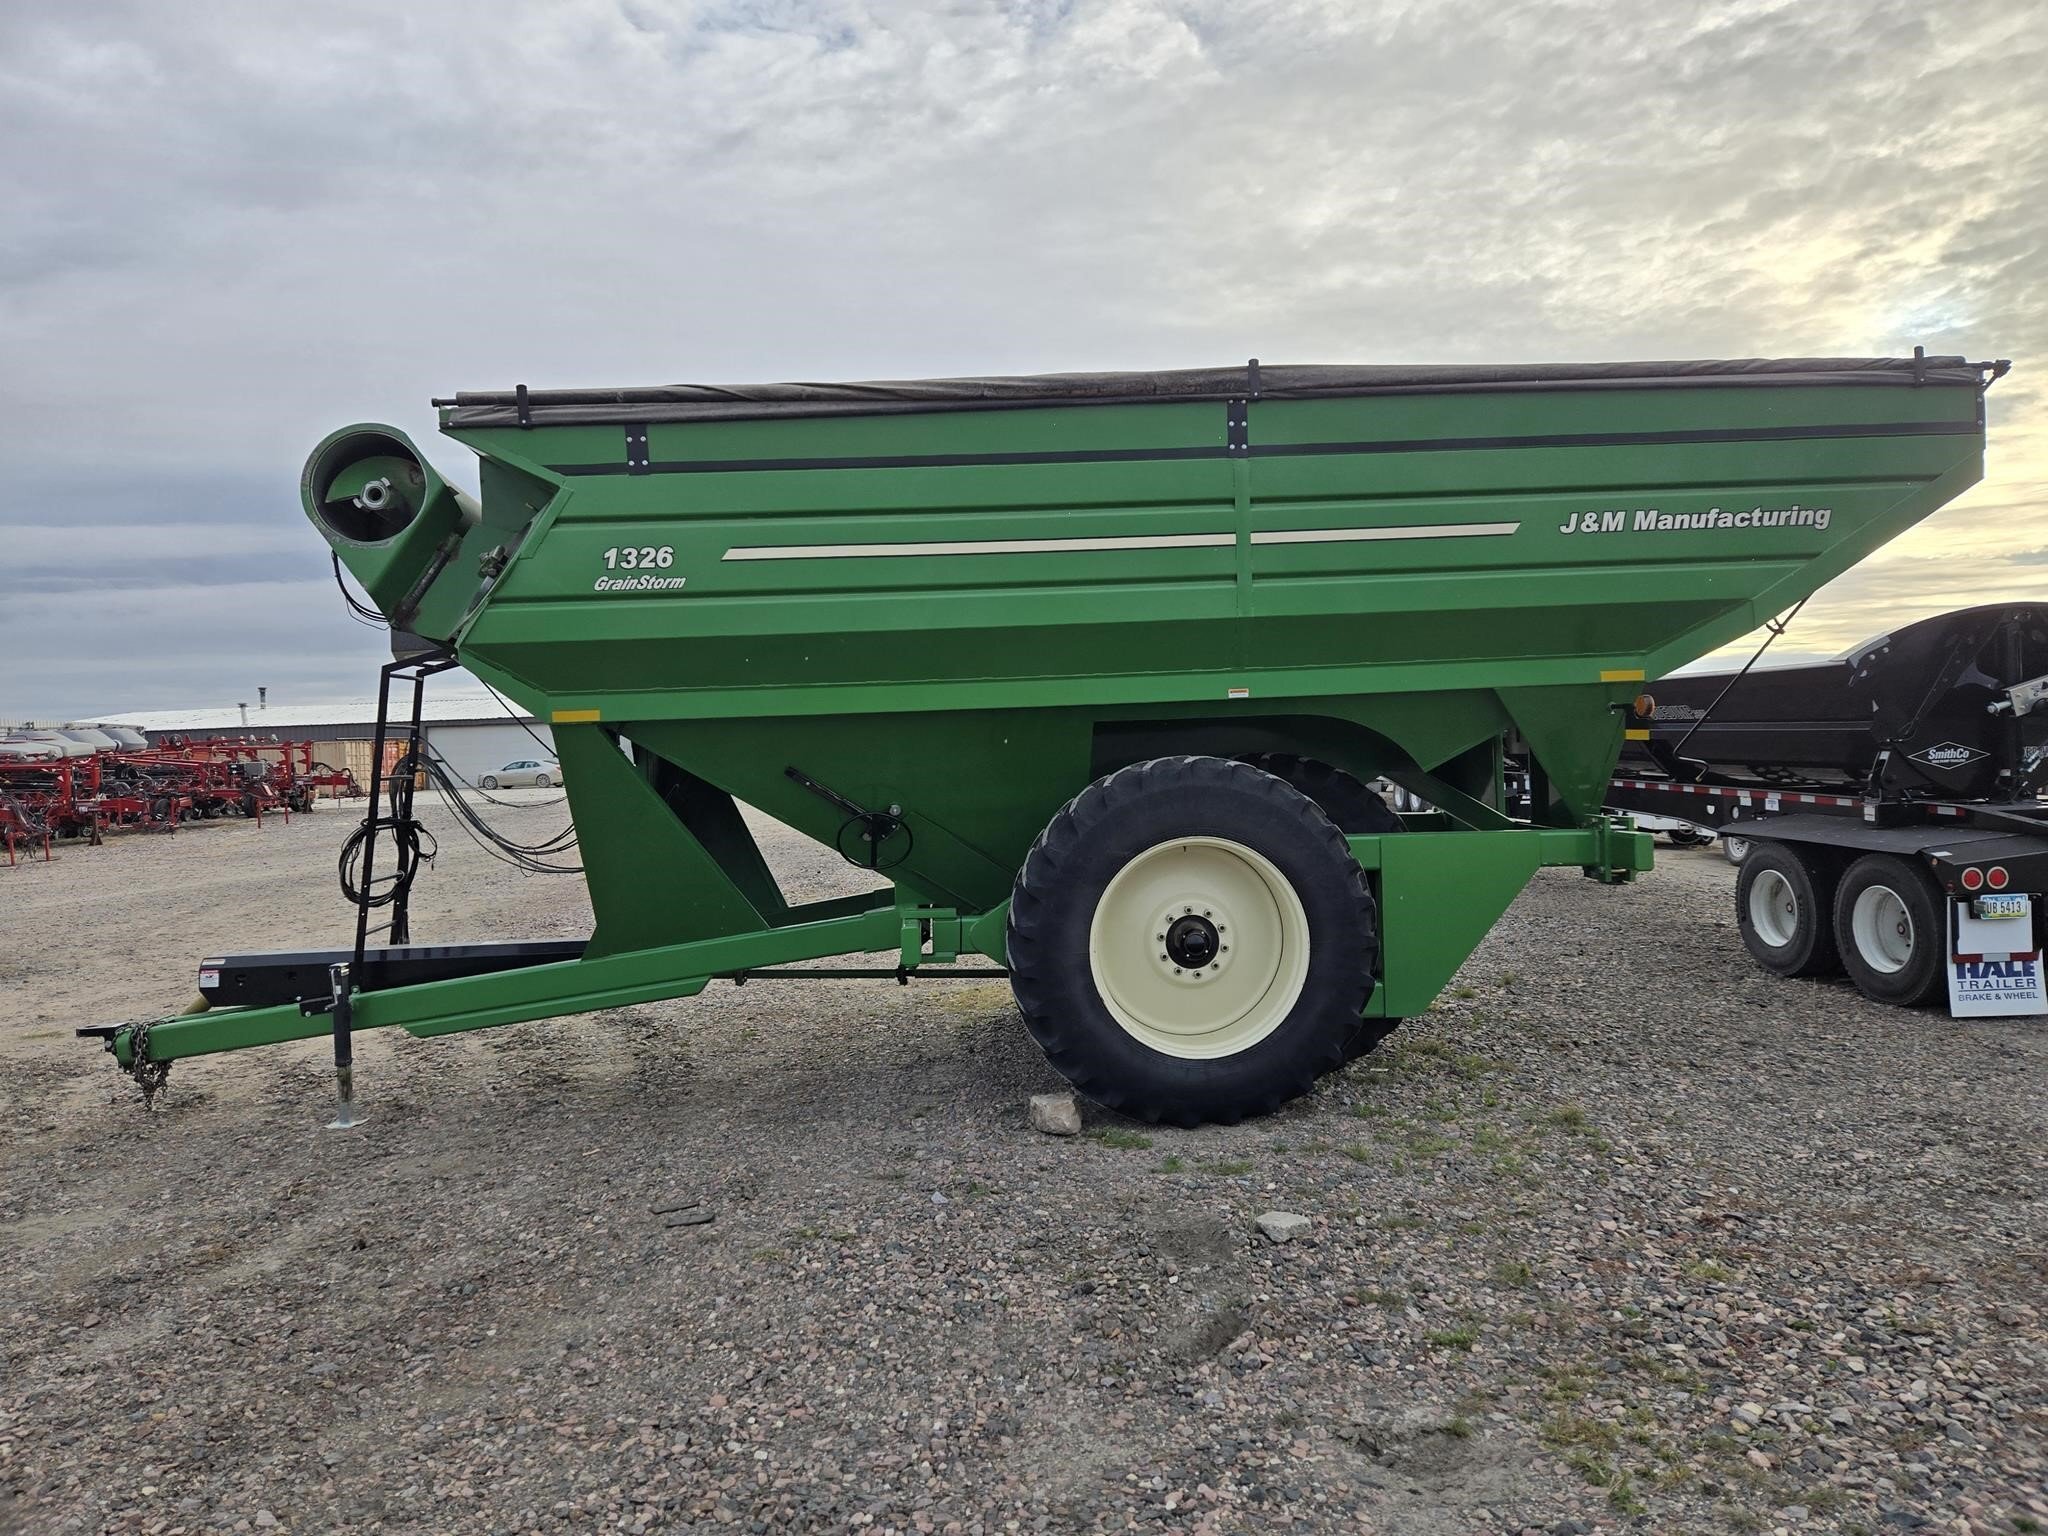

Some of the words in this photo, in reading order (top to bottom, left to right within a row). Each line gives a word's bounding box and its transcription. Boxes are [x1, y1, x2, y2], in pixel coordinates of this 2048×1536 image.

[1559, 511, 1626, 534] J&M
[1633, 506, 1832, 531] Manufacturing
[603, 545, 675, 570] 1326
[593, 574, 687, 591] GrainStorm
[1928, 748, 1970, 759] SmithCo
[1956, 961, 2035, 979] HALE
[1957, 978, 2037, 990] TRAILER
[1958, 993, 1992, 1002] BRAKE
[1994, 993, 2002, 1001] &
[2003, 991, 2039, 1000] WHEEL
